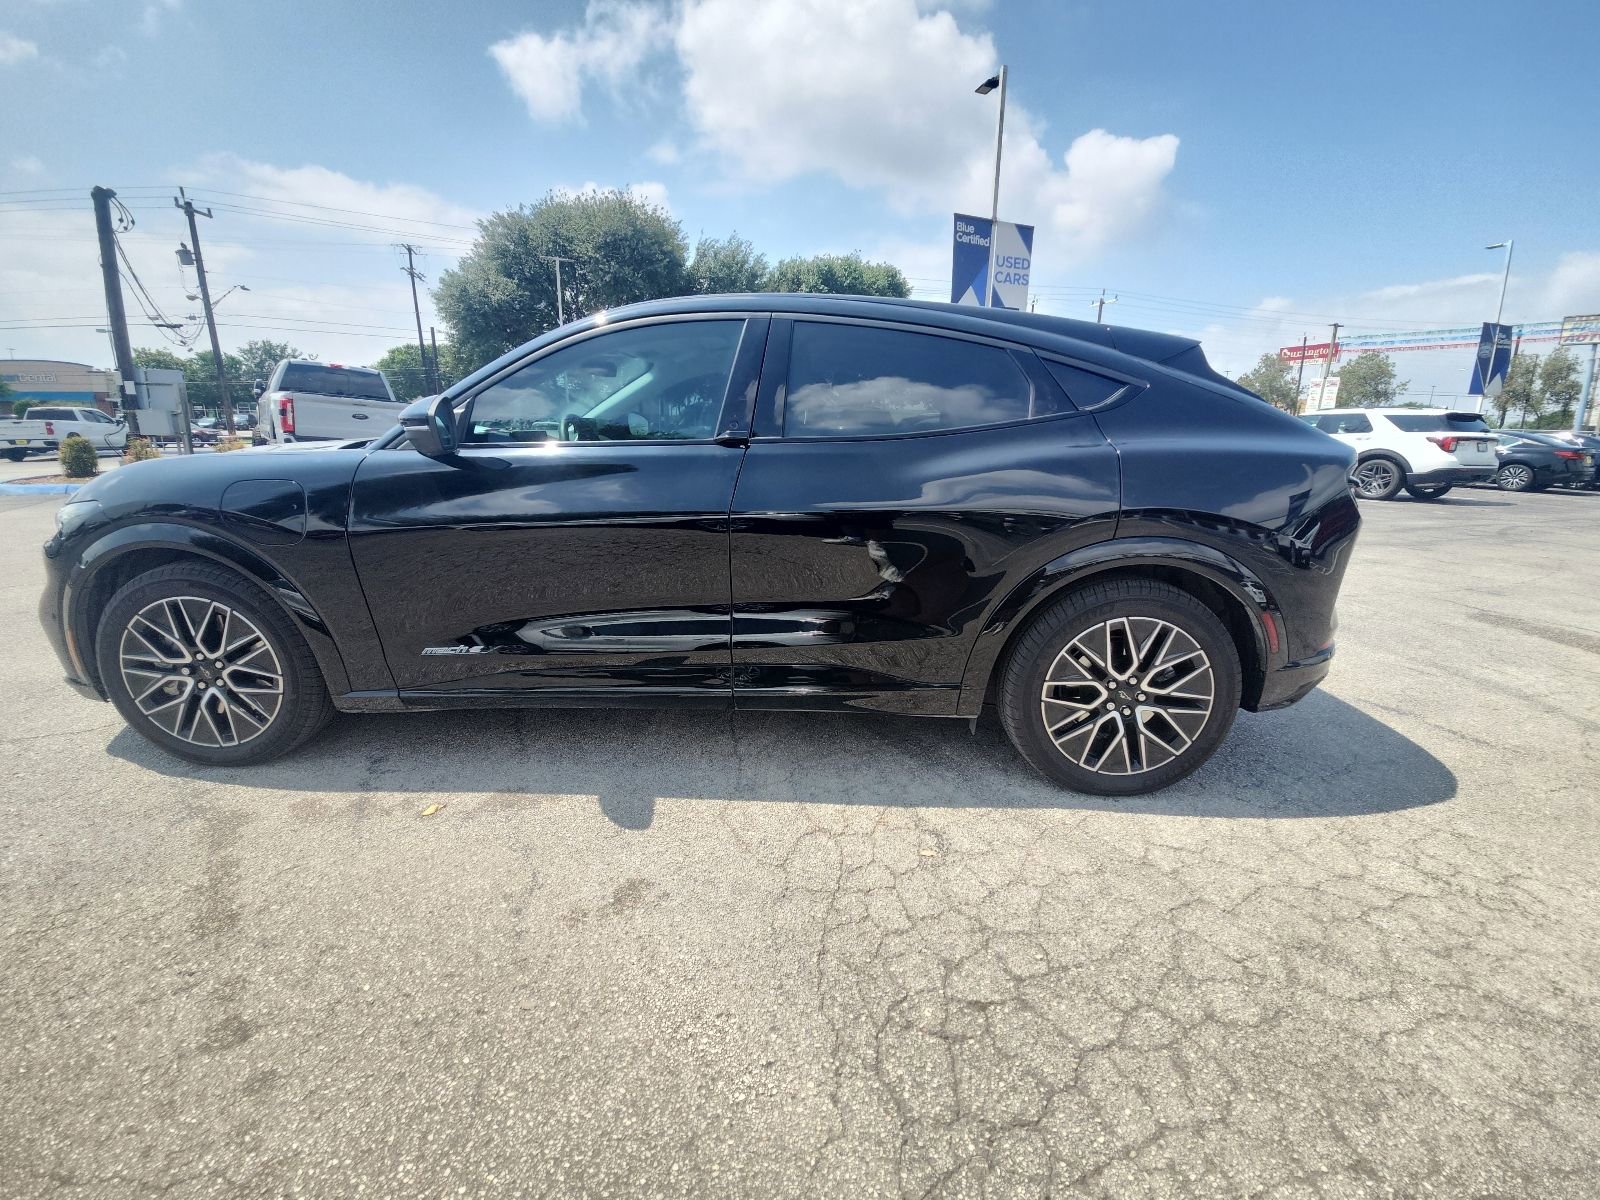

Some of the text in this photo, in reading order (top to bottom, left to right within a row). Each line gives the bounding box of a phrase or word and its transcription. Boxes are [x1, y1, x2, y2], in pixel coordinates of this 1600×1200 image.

[956, 221, 975, 233] Blue
[956, 233, 990, 247] Certified
[996, 254, 1030, 270] USED
[994, 271, 1029, 286] CARS
